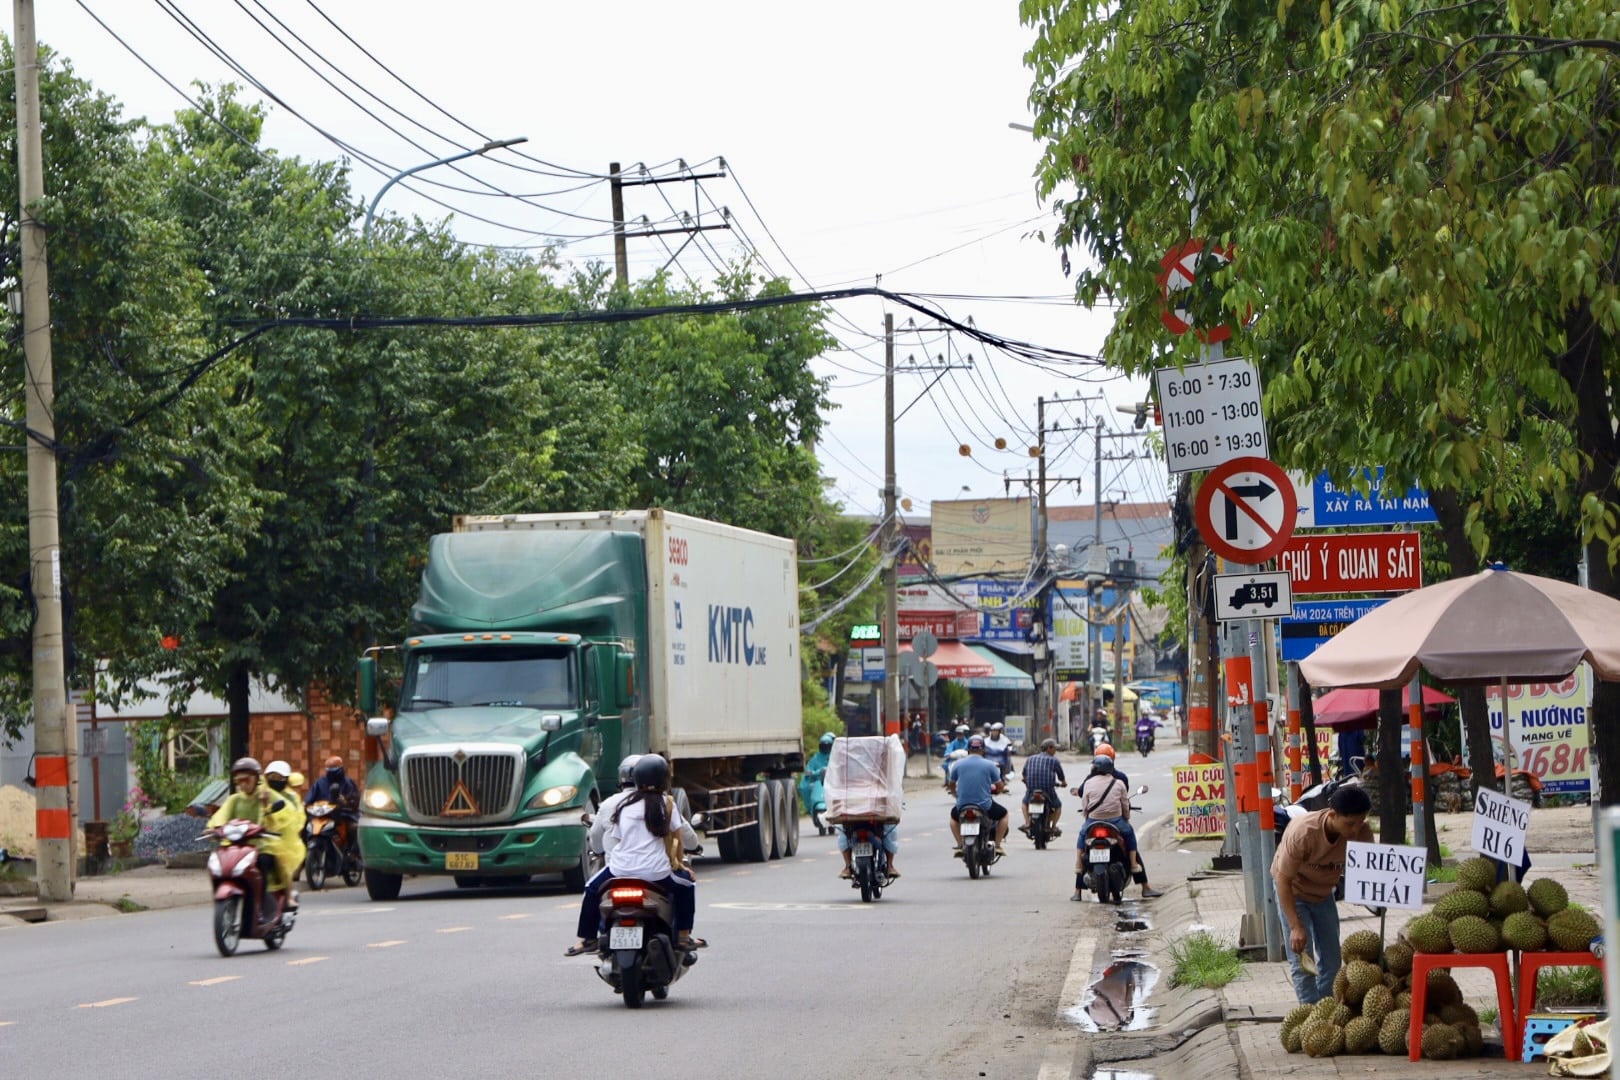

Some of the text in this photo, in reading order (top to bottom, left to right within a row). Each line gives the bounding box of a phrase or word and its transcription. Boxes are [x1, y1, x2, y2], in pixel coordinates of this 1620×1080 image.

[1168, 379, 1202, 397] 6:00
[1218, 371, 1251, 391] 7:30
[1168, 408, 1205, 428] 11:00
[1221, 401, 1259, 420] 13:00
[1171, 439, 1209, 458] 16:00
[1225, 431, 1262, 451] 19:30
[1355, 499, 1373, 511] RA
[1380, 498, 1398, 510] TAI
[1403, 497, 1429, 512] NẠN
[1282, 539, 1415, 581] CHÚ Ý QUAN SÁT
[1250, 586, 1273, 600] 3,5t
[1290, 606, 1308, 620] NĂM
[1309, 608, 1332, 620] 2024
[1334, 605, 1354, 619] TRÊN
[708, 604, 755, 666] KMTC
[755, 647, 767, 665] LINE
[1521, 704, 1585, 728] NƯỚNG
[1521, 728, 1572, 742] MANG VỀ
[1522, 742, 1590, 778] 168K
[1176, 766, 1199, 784] GIẢI
[1176, 784, 1226, 801] CAM
[1482, 827, 1513, 859] RI 6
[1347, 850, 1361, 868] S.
[1366, 847, 1425, 875] RIÊNG
[1356, 877, 1411, 905] THÁI
